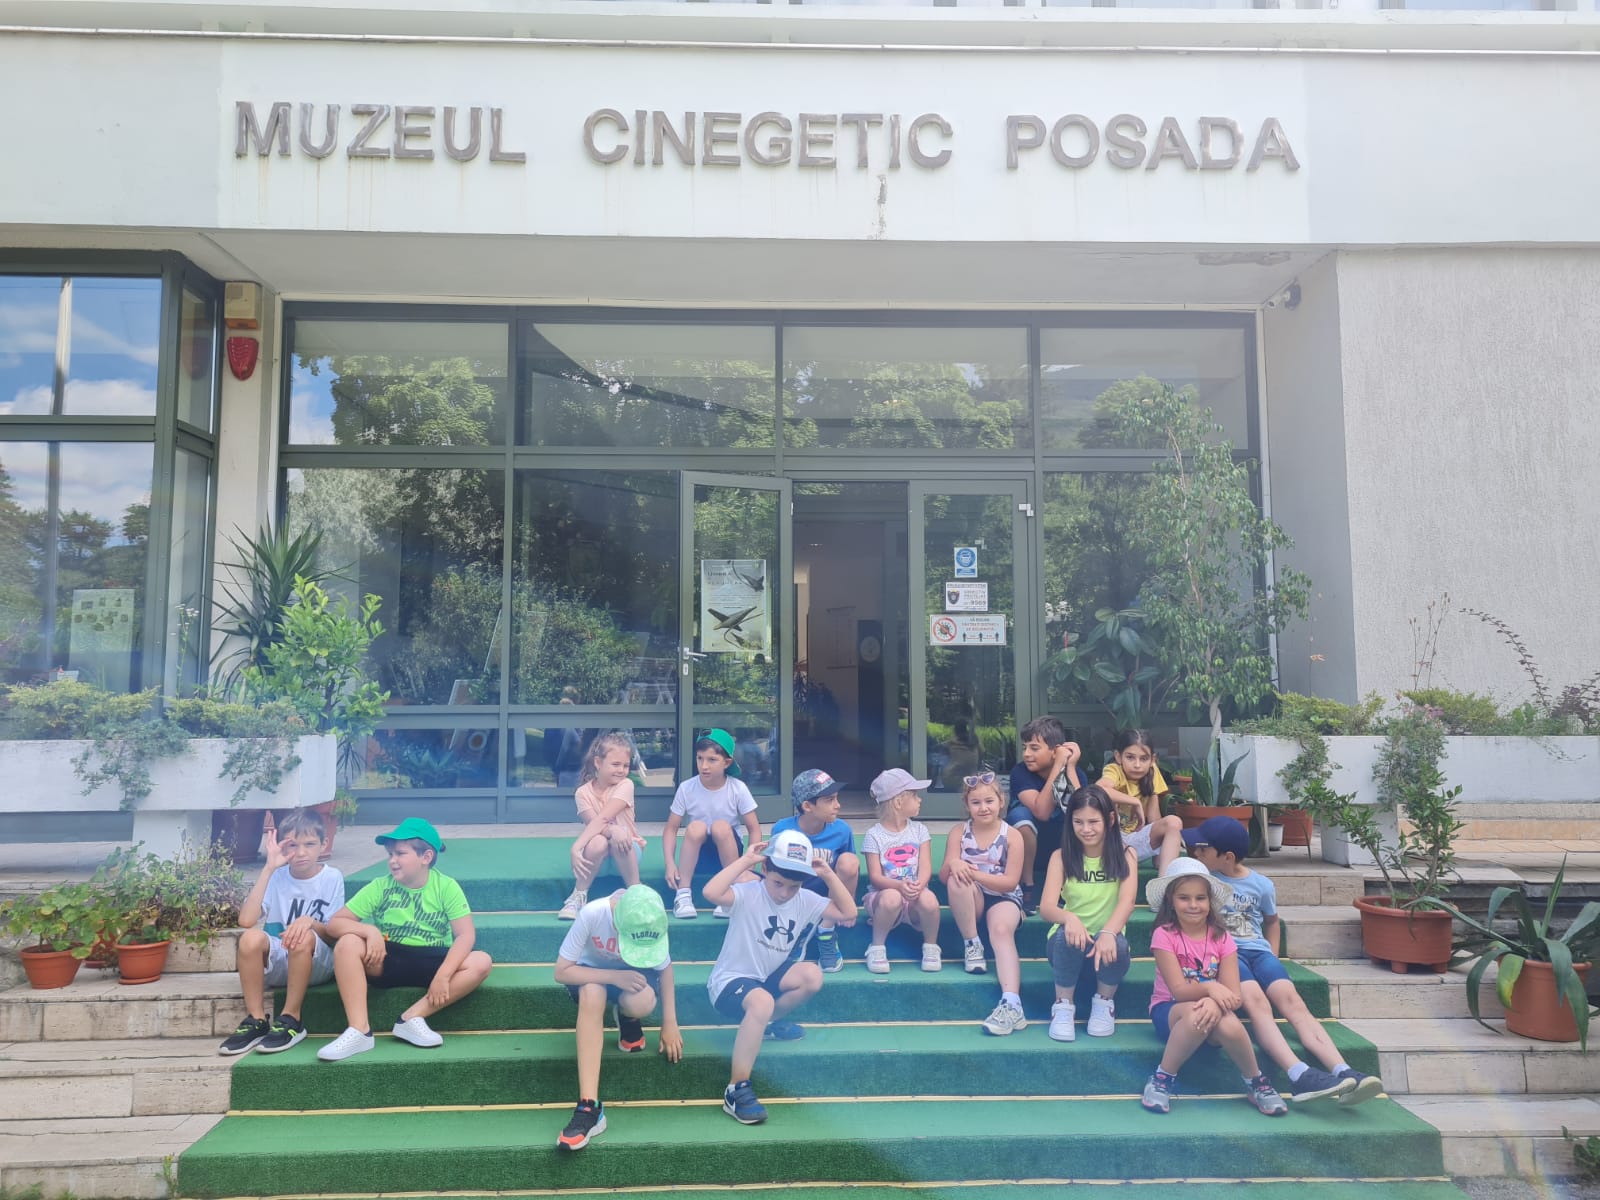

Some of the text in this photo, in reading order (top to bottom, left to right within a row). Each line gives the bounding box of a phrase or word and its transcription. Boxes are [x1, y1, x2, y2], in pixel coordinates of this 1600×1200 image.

[235, 100, 1301, 172] MUZEUL CINEGETIC POSADA
[631, 930, 660, 940] FLORIDA
